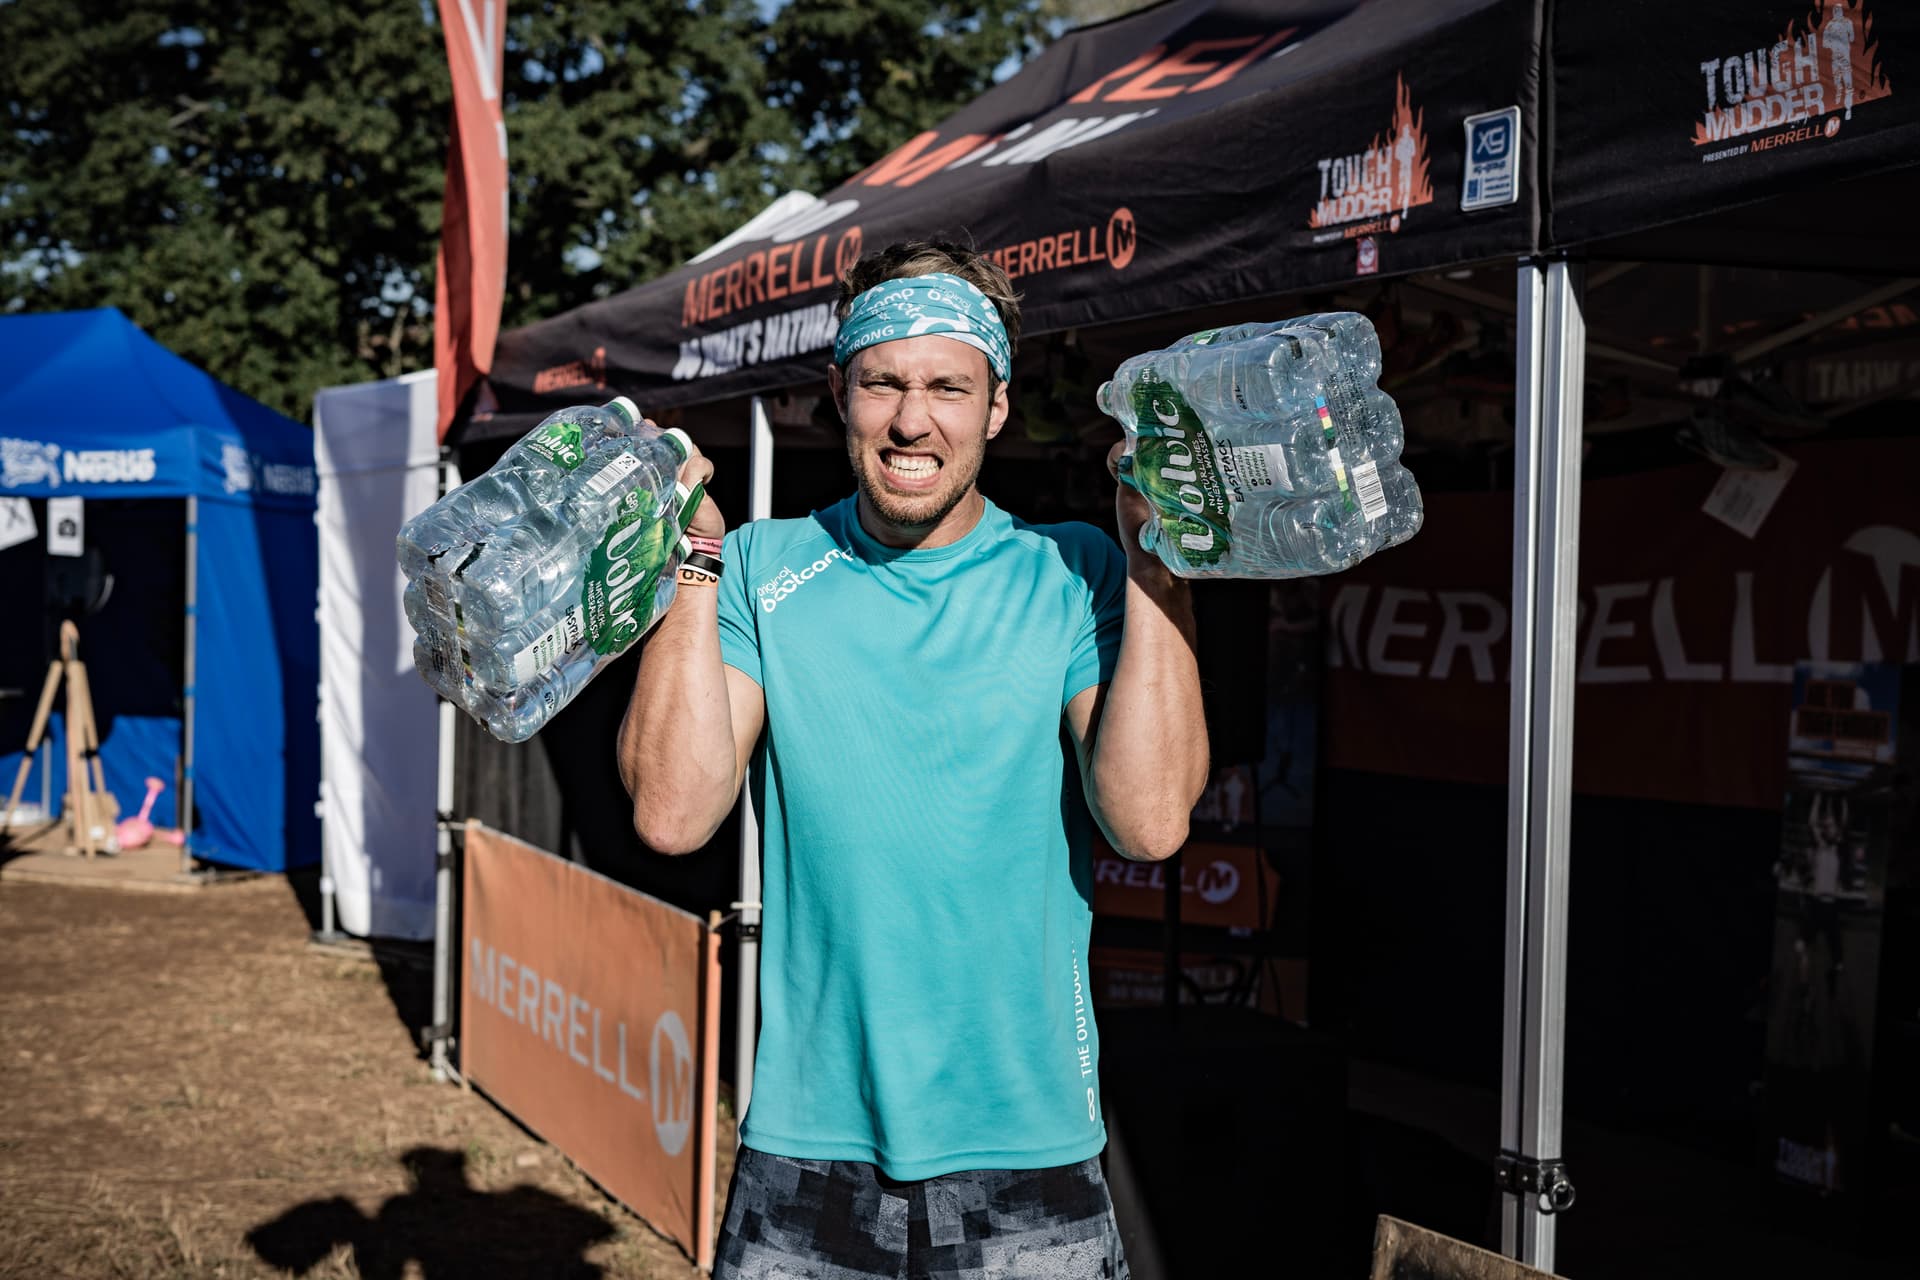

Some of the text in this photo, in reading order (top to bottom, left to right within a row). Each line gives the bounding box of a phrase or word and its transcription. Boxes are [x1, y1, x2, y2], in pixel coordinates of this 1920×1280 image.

[1701, 33, 1819, 109] TOUGH
[1705, 83, 1825, 141] MUDDER
[1317, 146, 1394, 201] TOUGH
[1703, 147, 1739, 163] PRESENTED
[1739, 144, 1749, 154] BY
[1751, 127, 1824, 152] MERRELL
[1316, 187, 1393, 226] MUDDER
[682, 234, 833, 328] MERRELL
[64, 449, 156, 482] Nestlé
[1153, 399, 1214, 552] Volvic
[1216, 439, 1245, 503] EASYPACK
[757, 565, 793, 597] original
[761, 546, 854, 613] bootcamp
[470, 937, 645, 1099] MERRELL
[1077, 1044, 1093, 1078] THE
